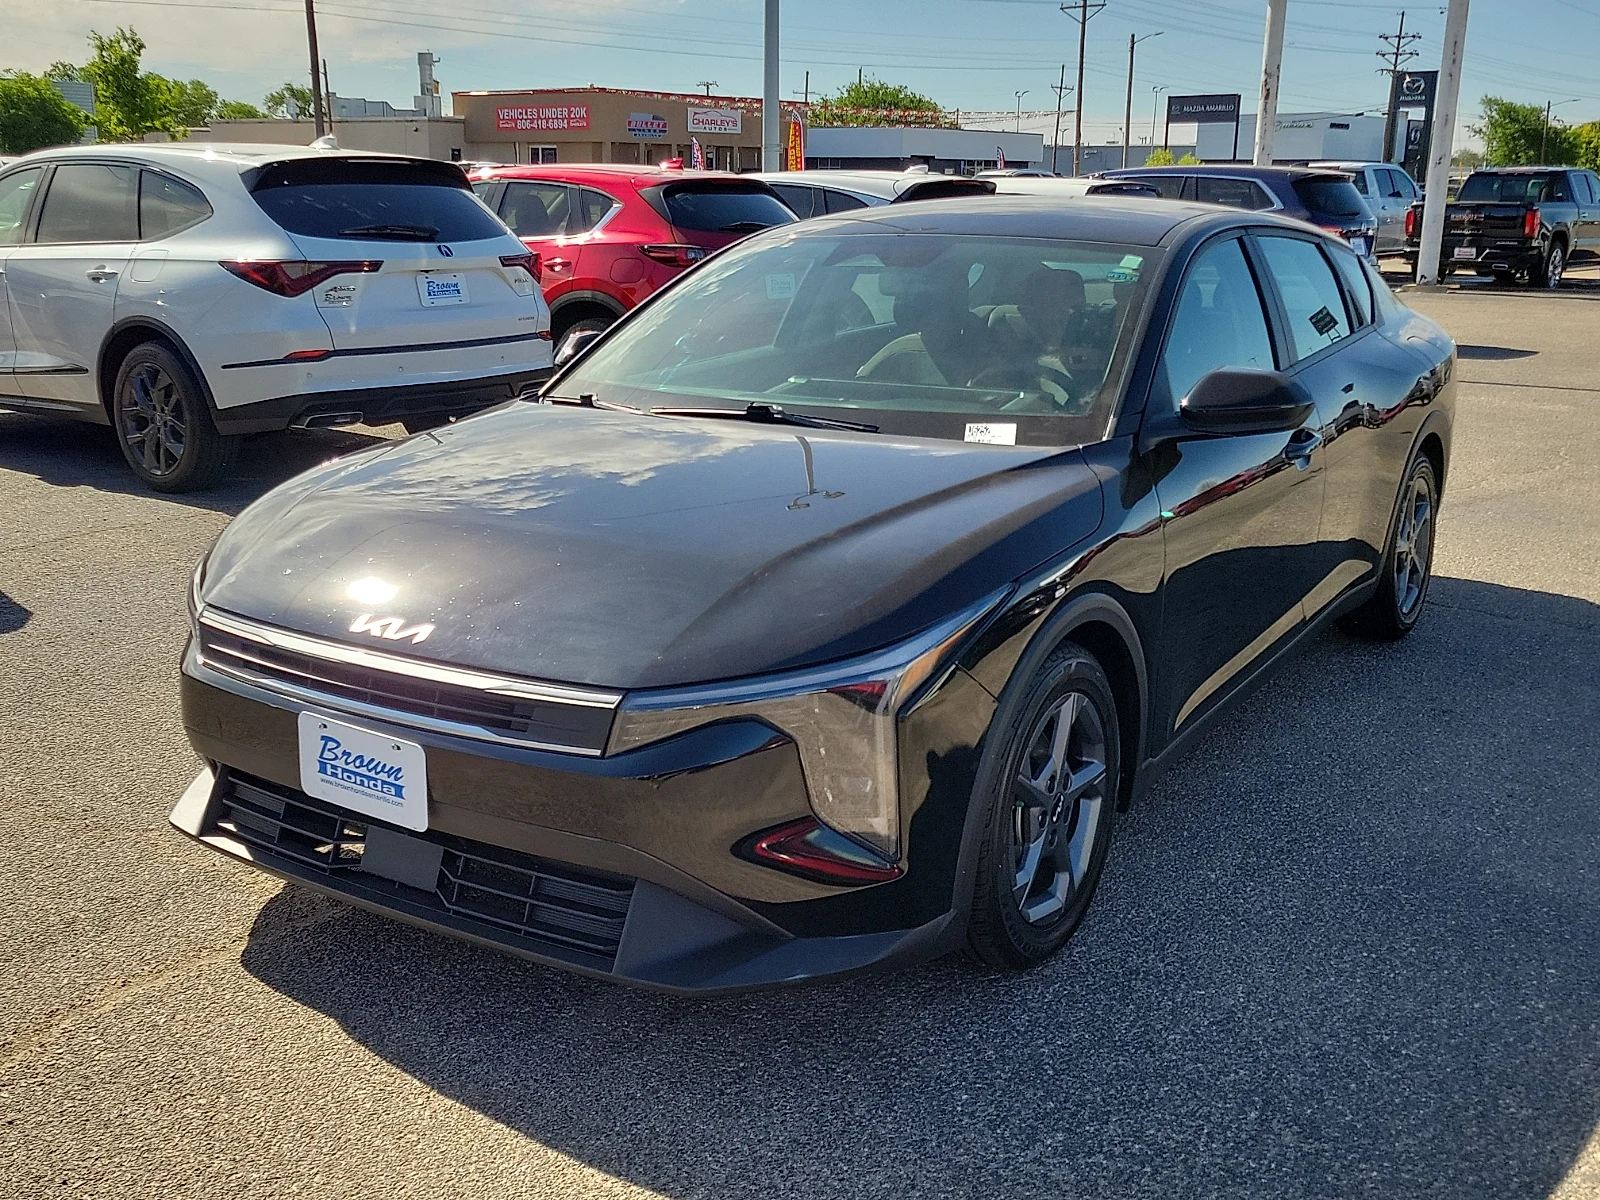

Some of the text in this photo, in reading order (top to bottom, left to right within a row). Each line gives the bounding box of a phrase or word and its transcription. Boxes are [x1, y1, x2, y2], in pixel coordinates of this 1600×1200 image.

[498, 106, 587, 120] VEHICLES UNDER 20K
[1183, 103, 1235, 112] MAZDA AMARILLO
[517, 119, 568, 130] 806-418-6894
[692, 117, 738, 128] CHARLEY'S
[426, 280, 459, 291] Brown
[318, 734, 404, 782] Brown
[326, 762, 397, 797] Honda
